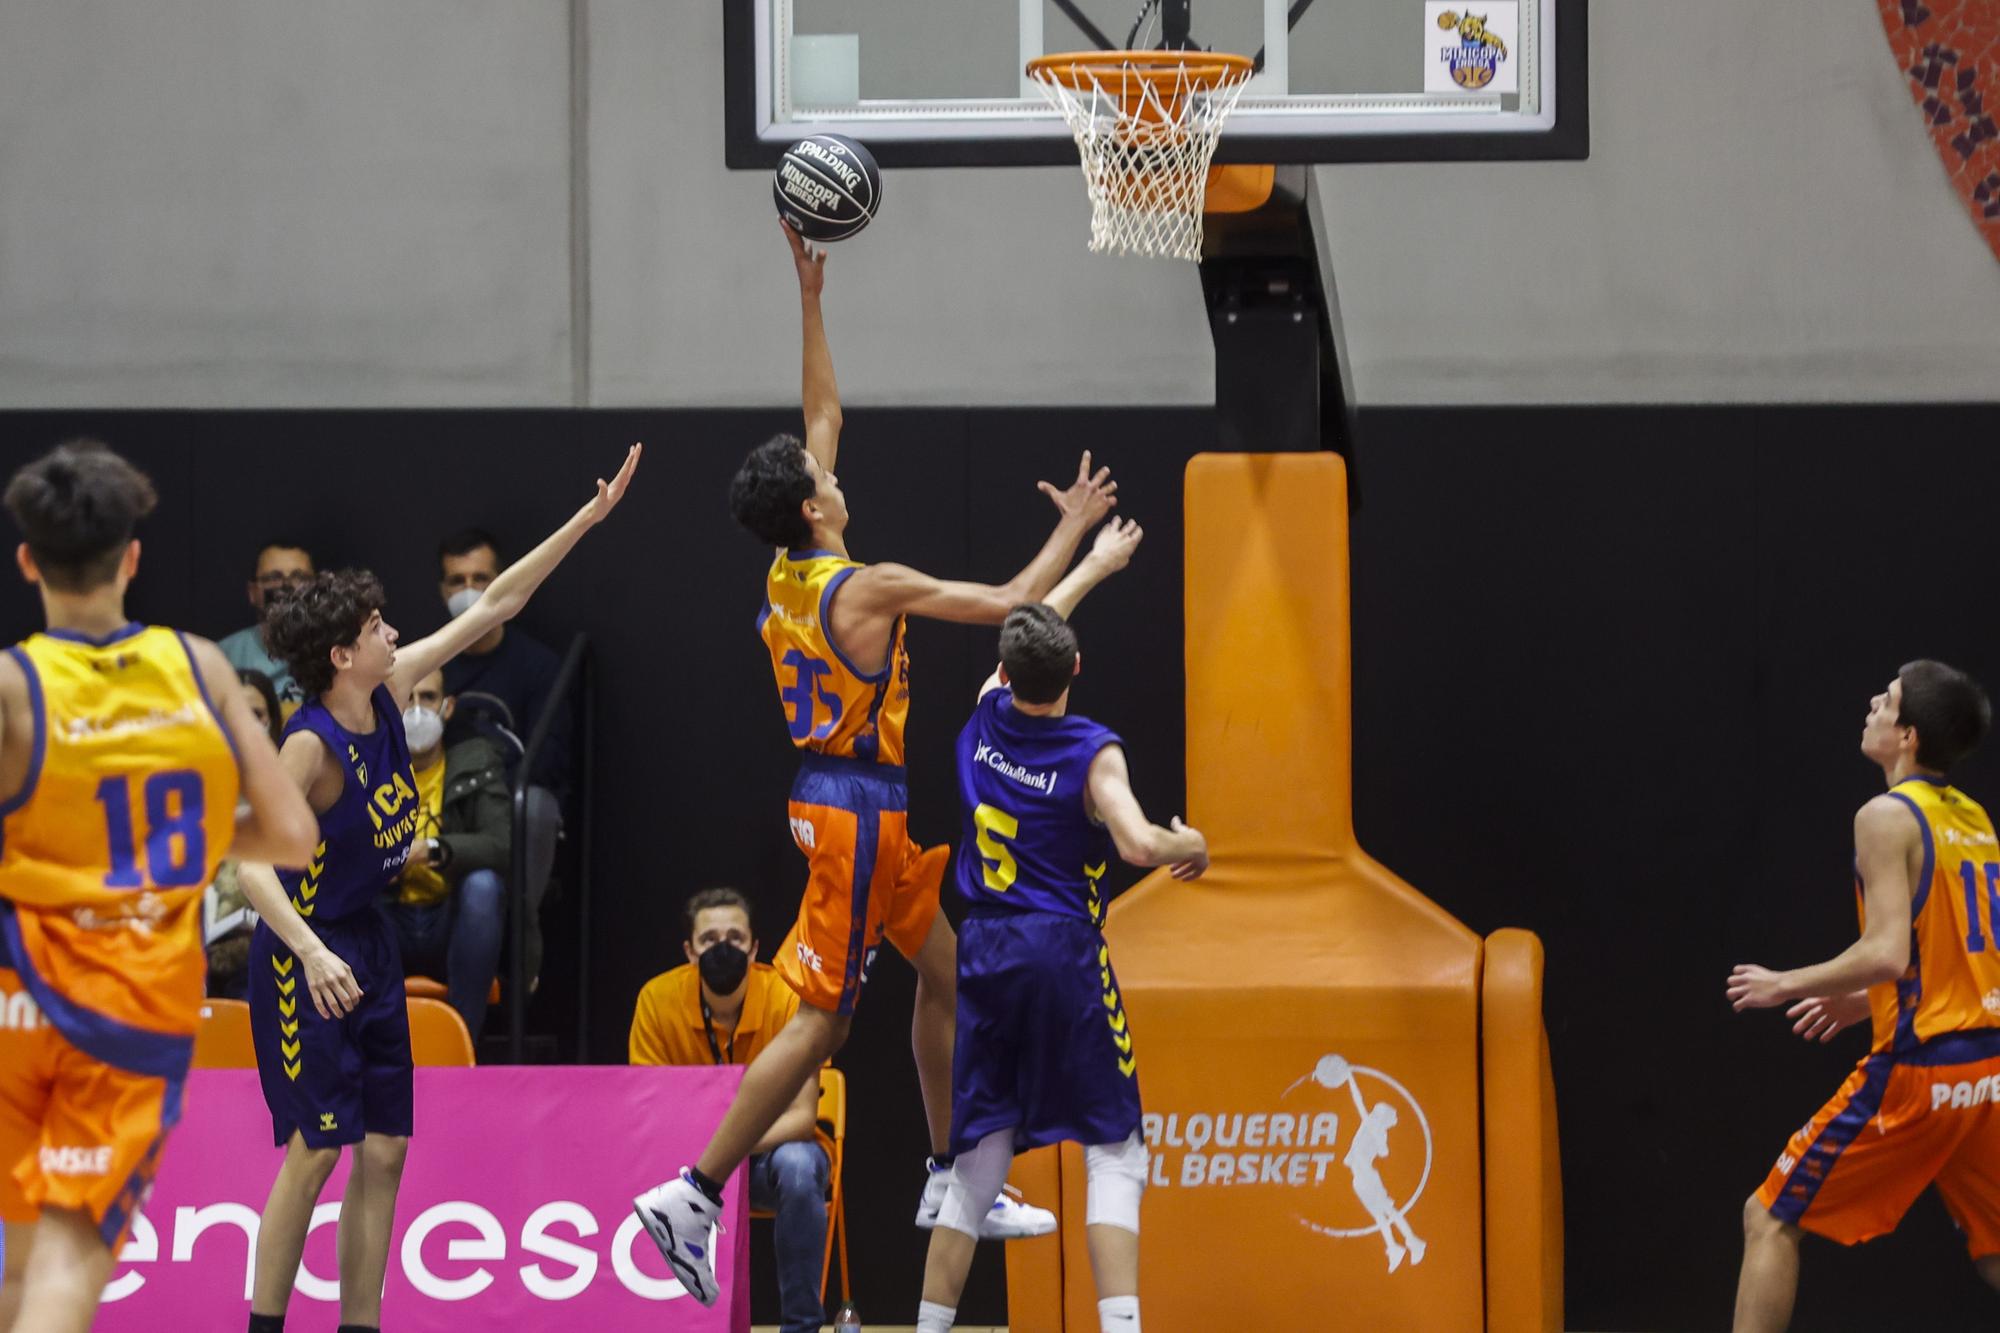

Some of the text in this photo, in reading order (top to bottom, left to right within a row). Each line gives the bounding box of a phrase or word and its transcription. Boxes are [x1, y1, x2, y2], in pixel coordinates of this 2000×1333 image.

[1440, 47, 1505, 62] MINICOPA
[780, 160, 842, 212] MINICOPA
[794, 140, 862, 192] SPALDING
[784, 180, 822, 211] ENDESA
[780, 648, 843, 739] 35
[95, 769, 206, 888] 18
[974, 802, 1019, 892] 5
[1141, 1113, 1339, 1152] ALQUERIA
[1180, 1153, 1335, 1188] BASKET
